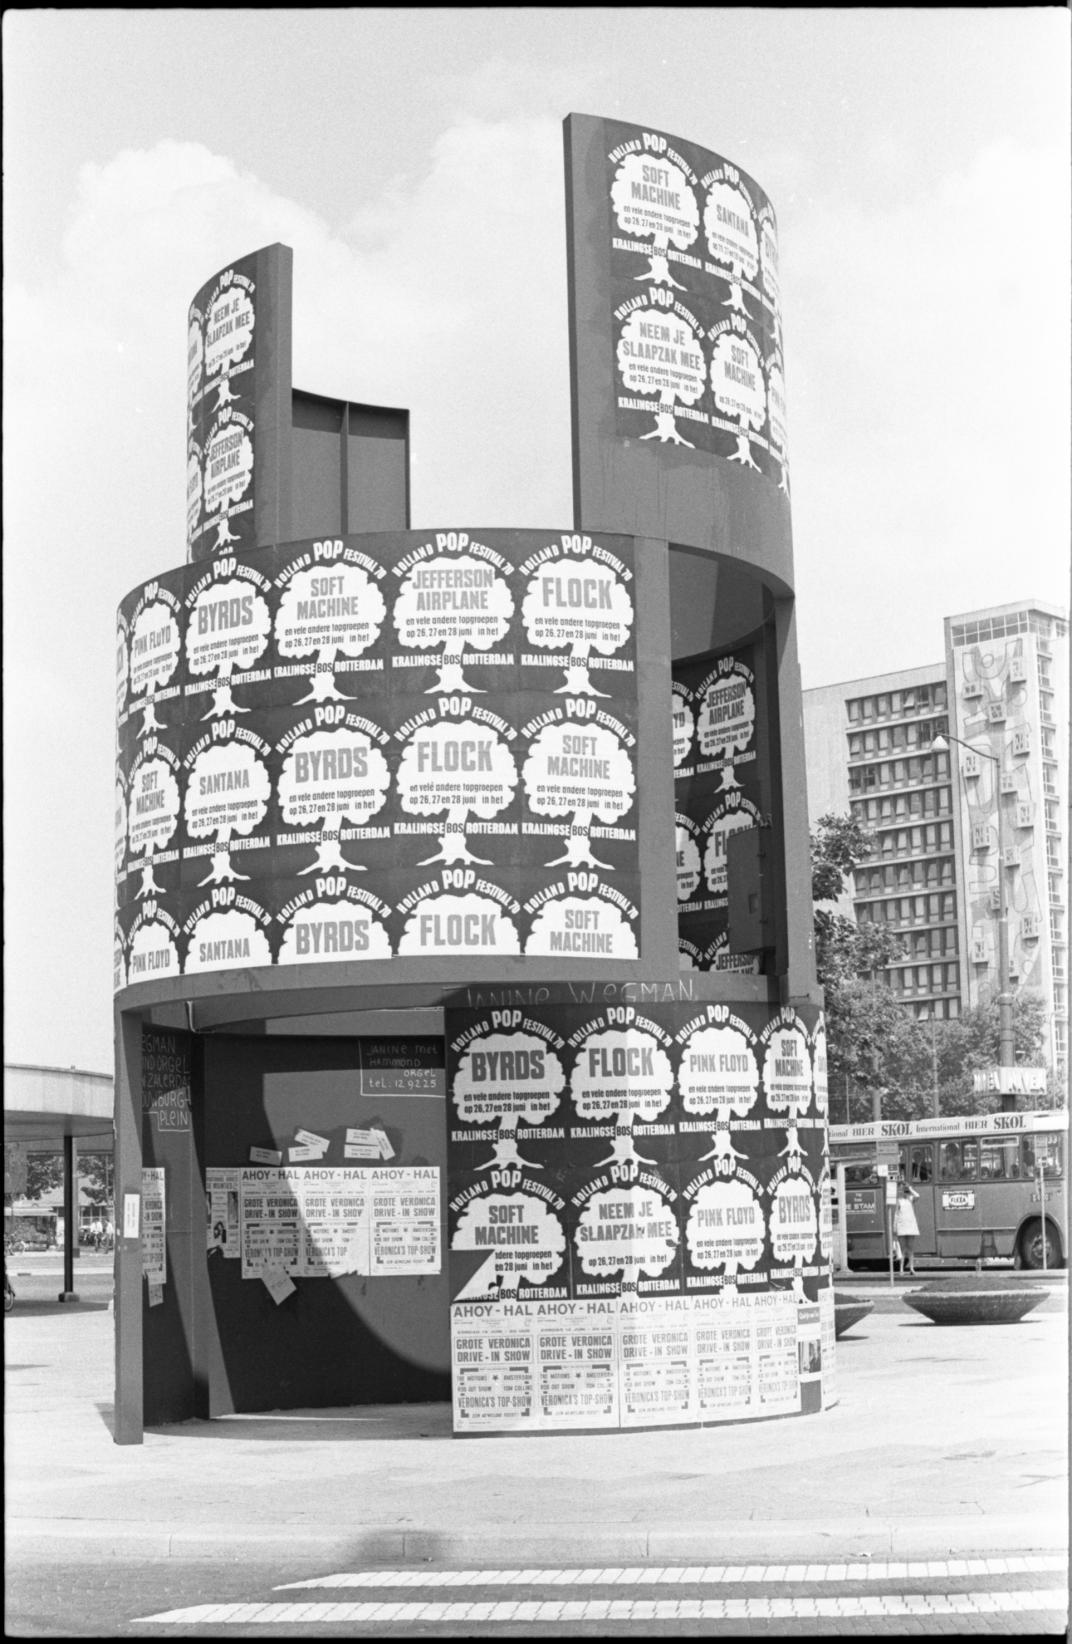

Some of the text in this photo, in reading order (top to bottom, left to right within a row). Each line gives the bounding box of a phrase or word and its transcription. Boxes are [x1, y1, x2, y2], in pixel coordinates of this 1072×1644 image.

[608, 133, 693, 180] HOLLAND POP FESTIVAL
[642, 165, 669, 188] SOFT
[723, 162, 739, 183] POP
[631, 182, 681, 210] MACHINE
[716, 204, 749, 238] SANTANA
[612, 237, 653, 256] KRALINGSE
[667, 249, 702, 269] ROTTERDAM
[649, 287, 673, 308] POP
[214, 298, 240, 324] NEEM JE
[206, 311, 250, 348] SLAAPZAK MEE
[639, 322, 686, 346] NEEM JE
[731, 314, 747, 334] POP
[622, 341, 701, 371] SLAAPZAK MEE
[730, 345, 749, 366] SOFT
[724, 361, 756, 391] MACHINE
[209, 430, 243, 462] JEFFERSON
[210, 450, 240, 479] AIRPLANE
[561, 535, 592, 554] POP
[274, 540, 386, 588] HOLLAND POP FESTIVAL 70
[392, 533, 514, 577] HOLLAND POP FESTIVAL 70
[213, 558, 236, 578] POP
[310, 576, 344, 597] SOFT
[413, 570, 493, 589] JEFFERSON
[416, 591, 488, 611] AIRPLANE
[542, 577, 612, 610] FLOCK
[198, 595, 253, 635] BYRDS
[297, 597, 359, 620] MACHINE
[416, 617, 431, 625] vele
[432, 616, 457, 624] andere
[459, 616, 498, 625] topgroepen
[407, 630, 415, 638] op
[448, 628, 457, 636] 28
[459, 628, 472, 637] juni
[274, 658, 383, 677] KRALINGSE BOS ROTTERDAM
[392, 654, 514, 667] KRALINGSE BOS ROTTERDAM
[718, 656, 733, 674] POP
[707, 681, 746, 708] JEFFERSON
[315, 705, 345, 726] POP
[438, 697, 471, 716] POP
[566, 698, 596, 717] POP
[709, 700, 744, 725] AIRPLANE
[211, 720, 235, 740] POP
[563, 735, 597, 756] SOFT
[295, 747, 368, 783] BYRDS
[417, 741, 493, 772] FLOCK
[548, 756, 610, 779] MACHINE
[142, 771, 158, 792] SOFT
[199, 770, 250, 795] SANTANA
[136, 790, 165, 815] MACHINE
[394, 823, 518, 834] KRALINGSE BOS ROTTERDAM
[316, 877, 346, 898] POP
[442, 869, 475, 889] POP
[567, 872, 598, 891] POP
[211, 887, 235, 907] POP
[565, 909, 599, 930] SOFT
[296, 919, 369, 955] BYRDS
[420, 914, 496, 946] FLOCK
[200, 938, 250, 963] SANTANA
[550, 931, 612, 953] MACHINE
[133, 949, 170, 973] PINK FLOYD
[607, 1007, 635, 1024] POP
[707, 1005, 729, 1022] POP
[780, 1007, 795, 1023] POP
[451, 1010, 565, 1052] HOLLAND POP FESTIVAL 70
[781, 1040, 798, 1057] SOFT
[472, 1050, 545, 1082] BYRDS
[589, 1048, 653, 1078] FLOCK
[690, 1054, 748, 1072] PINK FLOYD
[775, 1058, 803, 1077] MACHINE
[452, 1128, 564, 1141] KRALINGSE BOS ROTTERDAM
[881, 1123, 912, 1136] SKOL
[993, 1116, 1026, 1129] SKOL
[242, 1171, 300, 1179] AHOY HAL
[304, 1171, 367, 1179] AHOY HAL
[372, 1170, 437, 1179] AHOY HAL
[611, 1166, 638, 1182] POP
[714, 1159, 736, 1176] POP
[491, 1171, 521, 1188] POP
[374, 1198, 395, 1206] GROTE
[414, 1208, 435, 1216] SHOW
[599, 1202, 653, 1220] NEEM JE
[779, 1195, 810, 1224] BYRDS
[489, 1205, 524, 1224] SOFT
[698, 1206, 755, 1227] PINK FLOYD
[475, 1226, 539, 1245] MACHINE
[647, 1221, 672, 1238] MEE
[577, 1279, 680, 1295] KRALINGSE BOS ROTTERDAM
[454, 1305, 533, 1317] AHOY HAL
[537, 1303, 614, 1315] AHOY HAL
[620, 1299, 689, 1313] AHOY HAL
[694, 1297, 752, 1309] AHOY HAL
[456, 1338, 530, 1350] GROTE VERONICA
[505, 1351, 530, 1361] SHOW
